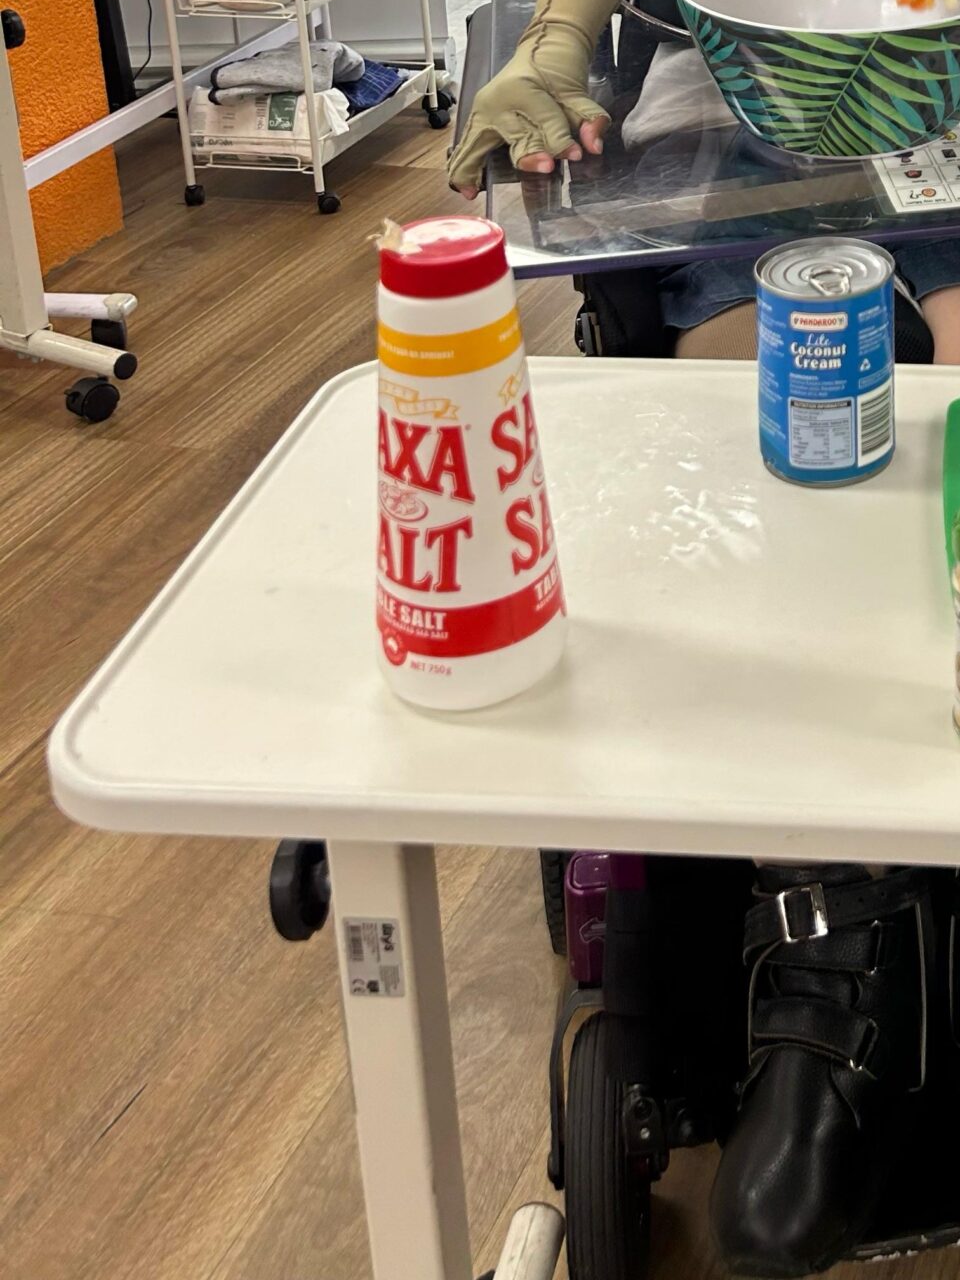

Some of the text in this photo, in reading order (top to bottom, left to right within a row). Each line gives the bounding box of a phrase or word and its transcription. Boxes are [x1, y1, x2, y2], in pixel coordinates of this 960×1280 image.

[806, 332, 832, 346] Lite
[790, 342, 848, 357] Coconut
[794, 355, 842, 369] Cream
[400, 605, 447, 631] SALT
